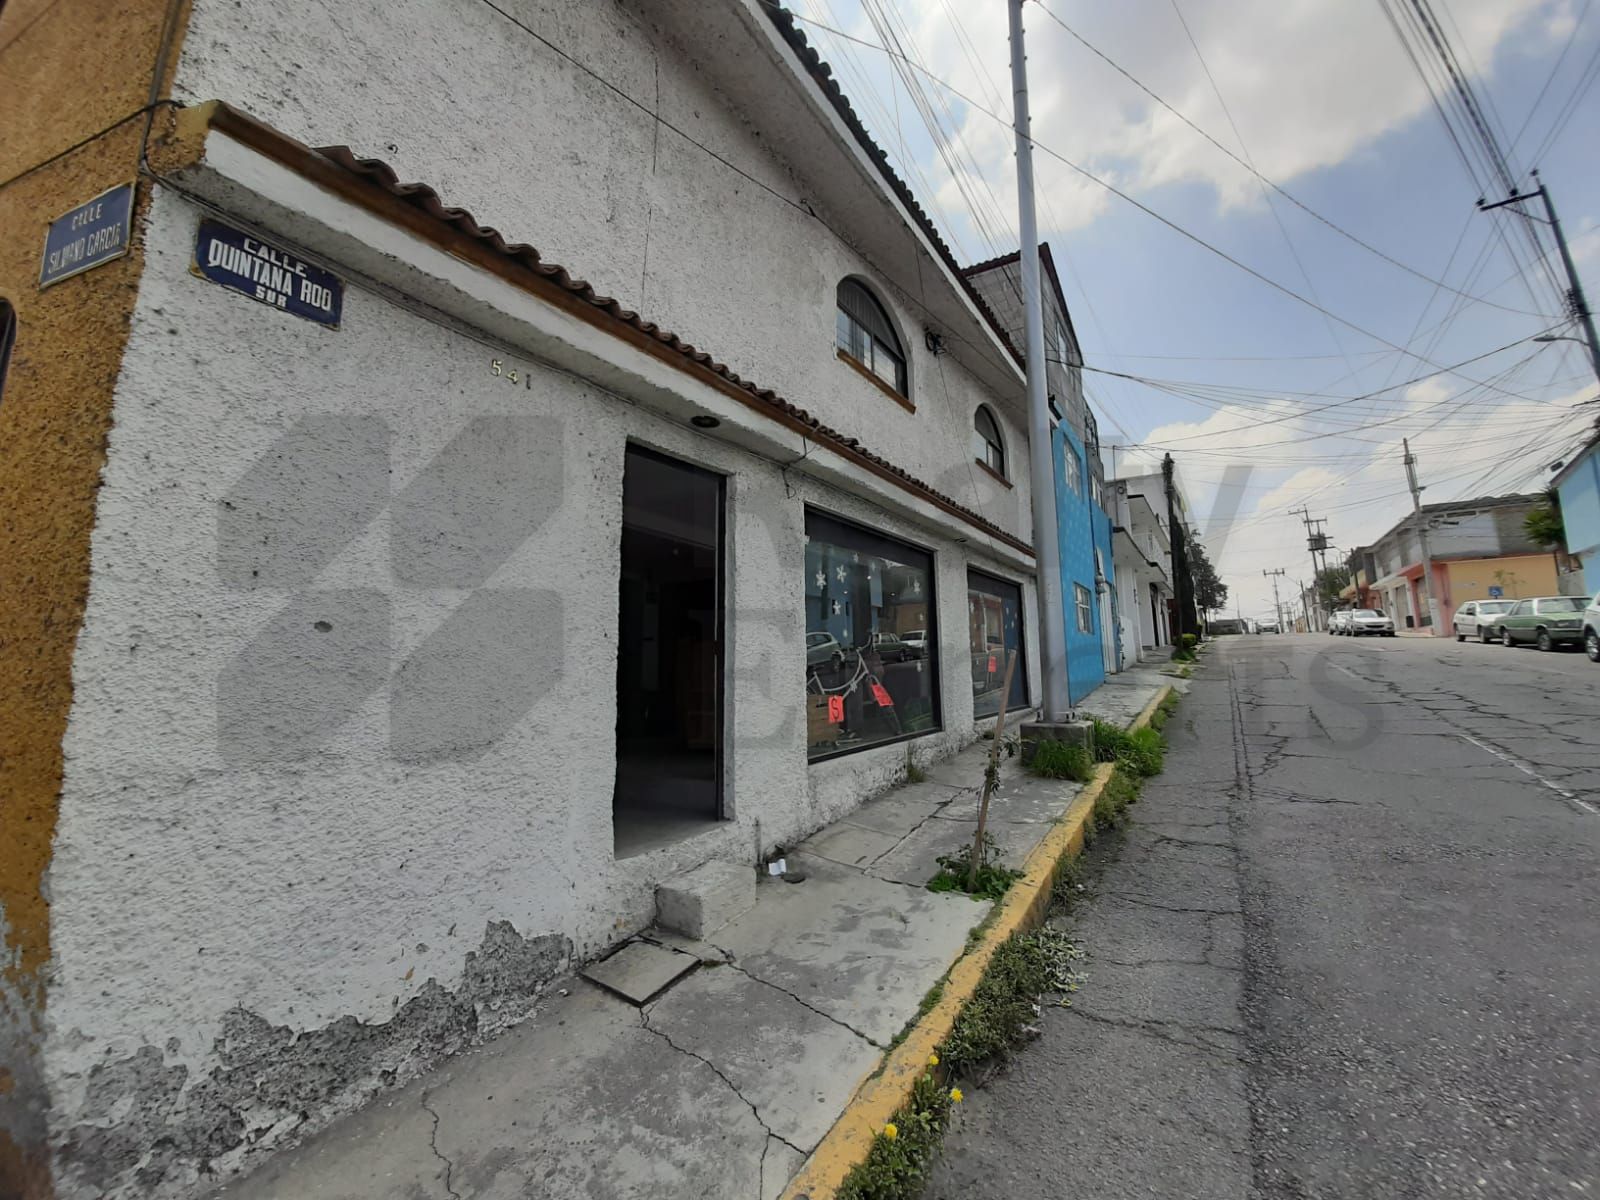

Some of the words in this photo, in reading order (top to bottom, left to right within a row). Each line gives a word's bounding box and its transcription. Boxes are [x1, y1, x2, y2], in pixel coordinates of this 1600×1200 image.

[72, 203, 103, 231] CALLE
[243, 238, 309, 278] CALLE
[207, 238, 293, 297] QUINTANA
[299, 279, 332, 312] ROO
[255, 284, 287, 308] SUR
[490, 358, 532, 390] 541
